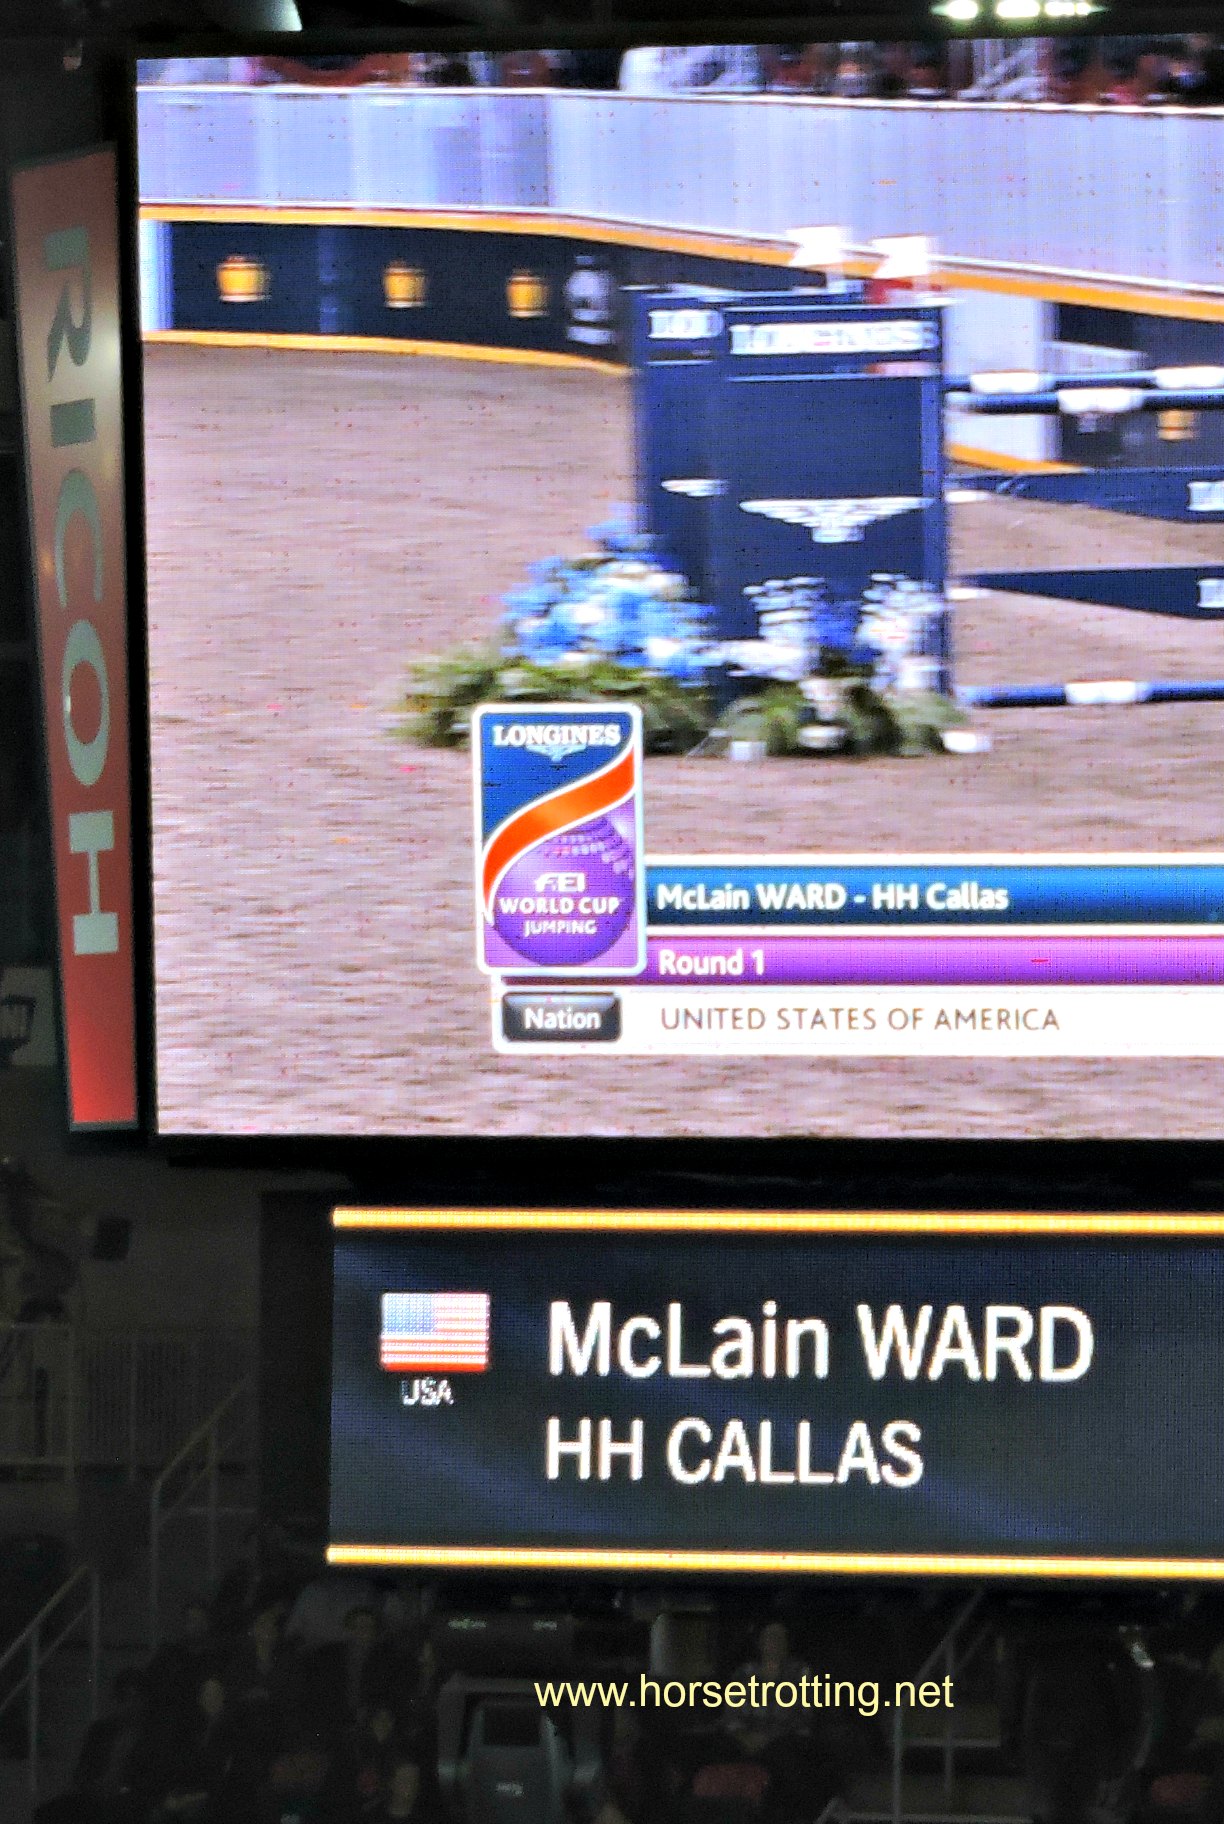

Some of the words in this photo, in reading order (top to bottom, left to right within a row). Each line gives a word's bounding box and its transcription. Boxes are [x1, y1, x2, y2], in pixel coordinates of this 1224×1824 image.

[45, 228, 119, 955] RICOH
[492, 724, 621, 747] LONGINES
[499, 897, 574, 914] WORLD
[578, 897, 621, 914] CUP
[657, 881, 750, 910] McLain
[755, 882, 847, 910] WARD
[872, 882, 919, 910] HH
[926, 881, 1009, 910] Callas
[524, 919, 598, 937] JUMPING
[659, 950, 744, 976] Round
[752, 950, 765, 976] 1
[524, 1007, 602, 1031] Nation
[661, 1007, 766, 1030] UNITED
[776, 1007, 876, 1030] STATES
[888, 1007, 923, 1030] OF
[934, 1008, 1060, 1031] AMERICA
[548, 1300, 829, 1381] McLain
[855, 1303, 1096, 1384] WARD
[401, 1377, 454, 1405] USA
[545, 1416, 645, 1482] HH
[666, 1417, 925, 1490] CALLAS
